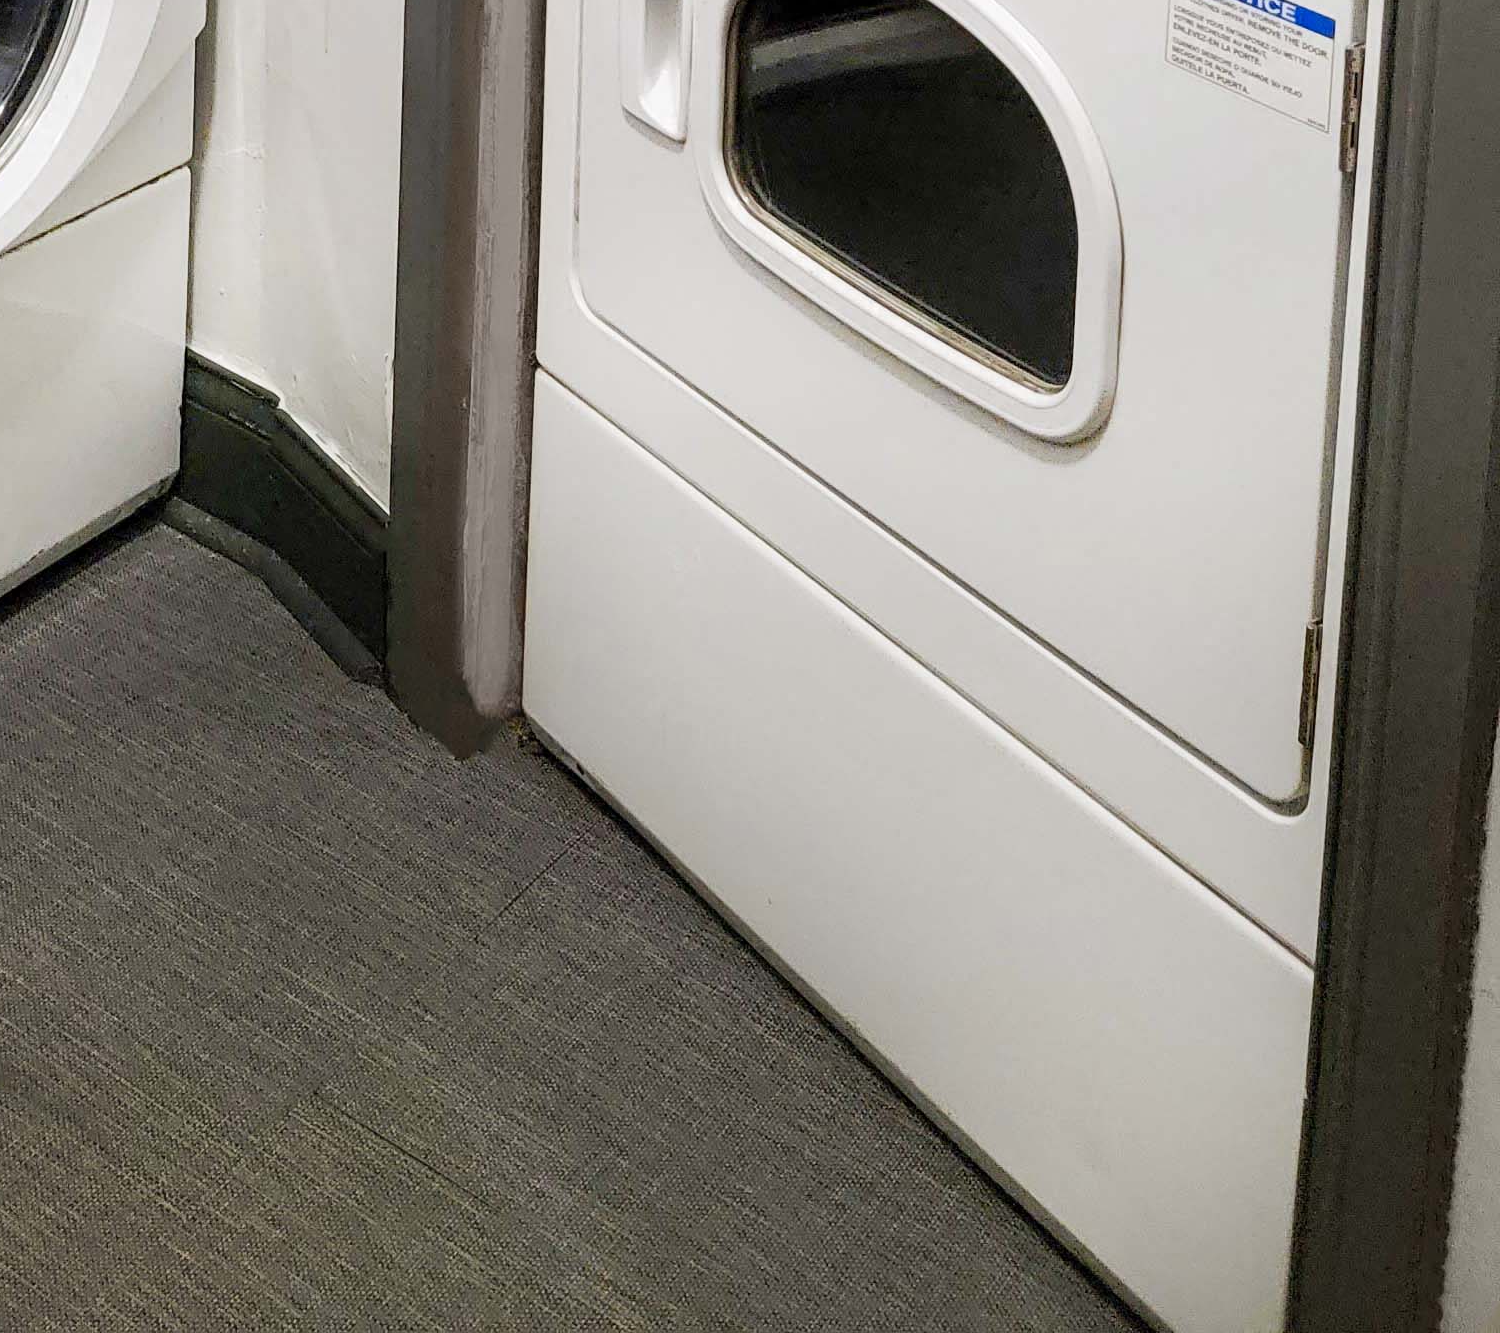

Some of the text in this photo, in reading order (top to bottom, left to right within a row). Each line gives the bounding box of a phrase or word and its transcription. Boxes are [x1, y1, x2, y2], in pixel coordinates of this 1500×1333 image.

[1248, 20, 1281, 39] REMOVE
[1284, 35, 1299, 46] THE
[1221, 44, 1231, 52] LA
